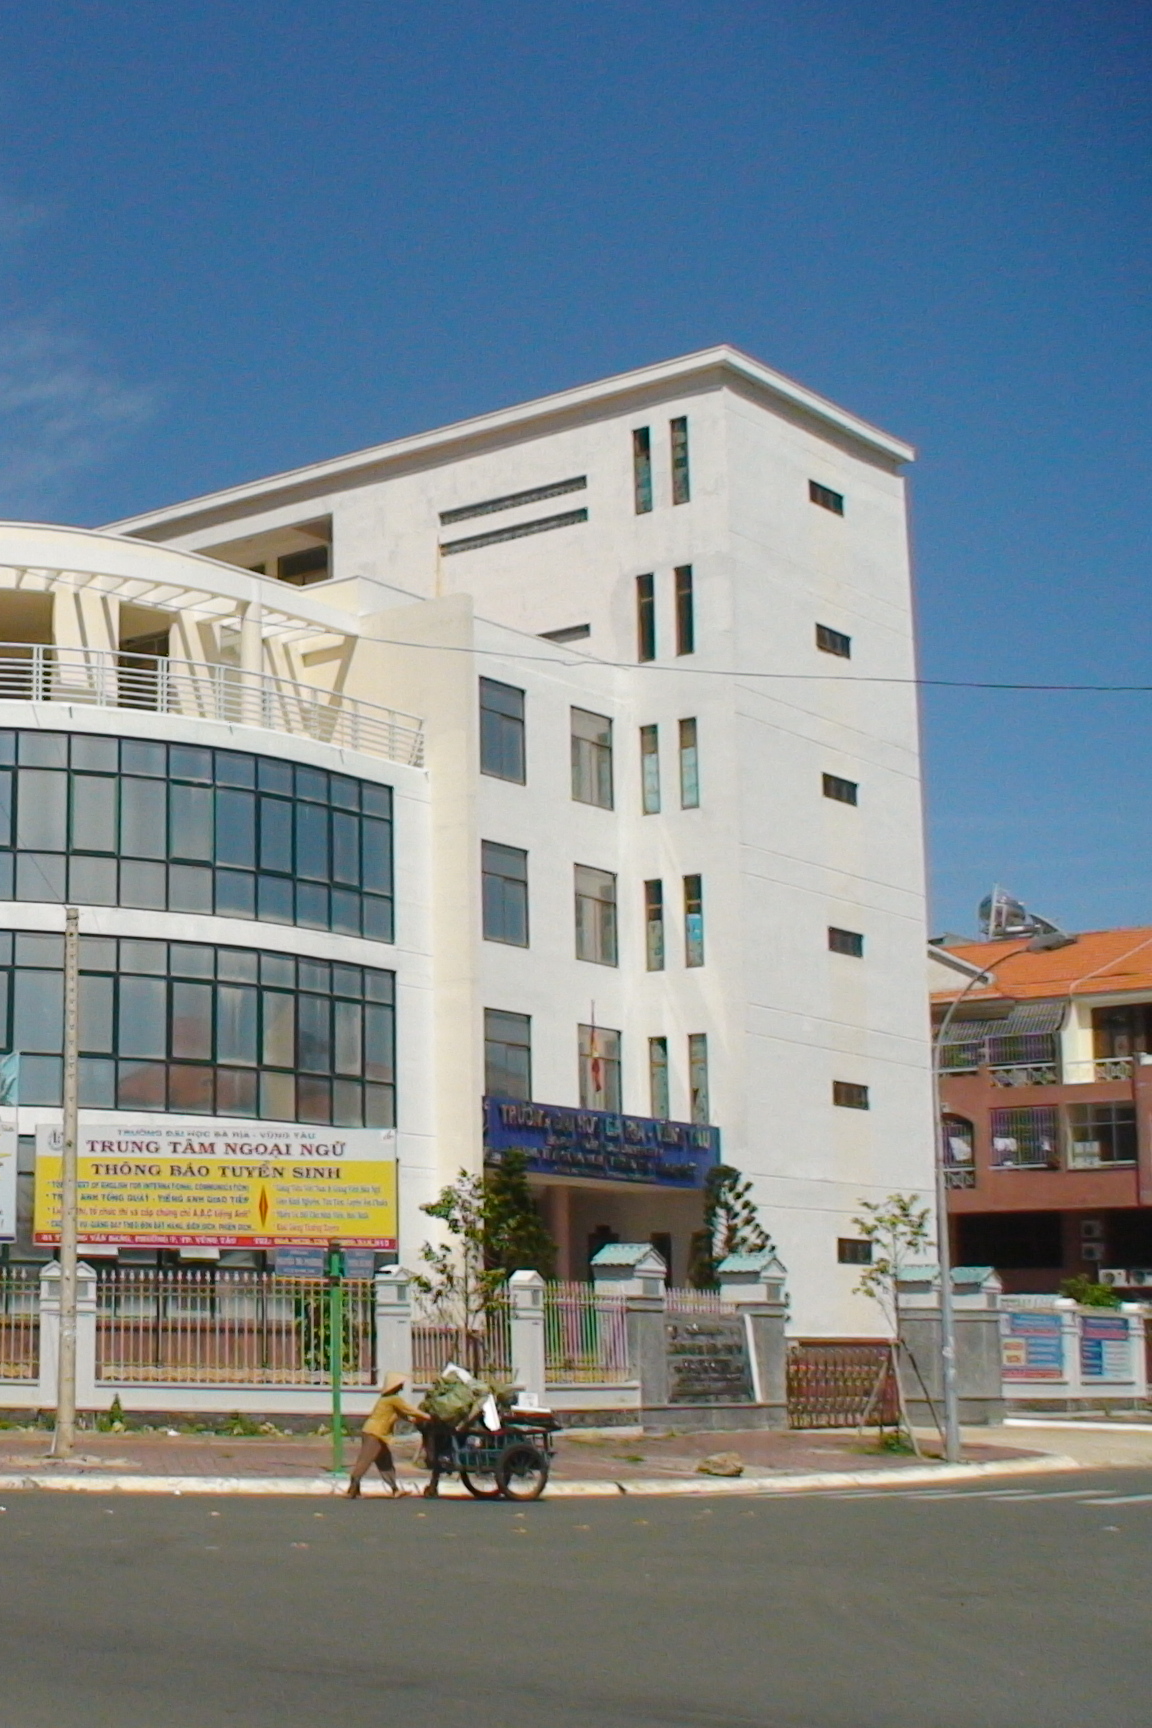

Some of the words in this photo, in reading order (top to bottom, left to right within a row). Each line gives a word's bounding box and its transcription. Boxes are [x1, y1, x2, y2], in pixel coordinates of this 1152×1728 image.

[86, 1140, 161, 1154] TRUNG
[168, 1139, 216, 1155] TÂM
[224, 1142, 292, 1159] NGOẠI
[300, 1140, 346, 1156] NGỮ
[91, 1161, 161, 1176] THÔNG
[218, 1160, 285, 1178] TUYỂN
[292, 1166, 342, 1179] SINH
